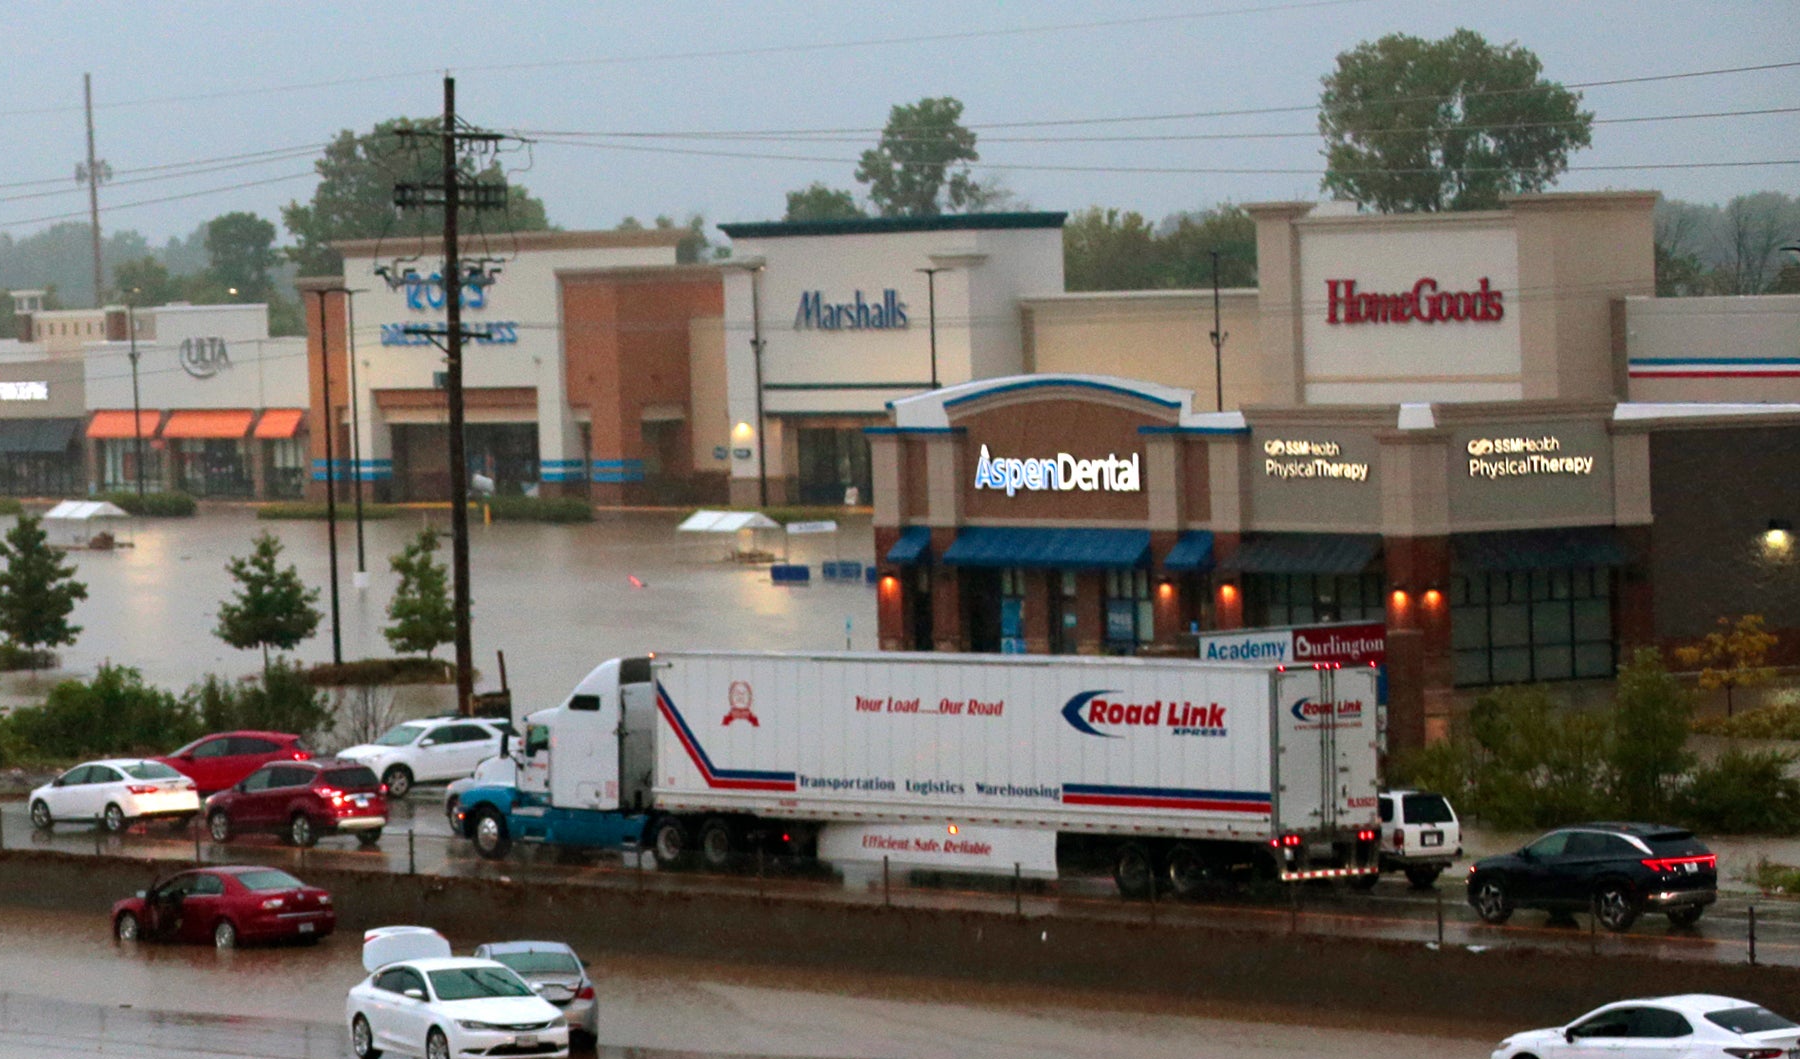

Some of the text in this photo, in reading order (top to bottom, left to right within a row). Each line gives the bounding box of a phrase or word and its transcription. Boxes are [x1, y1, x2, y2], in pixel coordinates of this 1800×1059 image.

[406, 272, 485, 309] ROS
[1325, 276, 1505, 325] HomeGoods
[793, 288, 908, 330] Marshalls
[185, 336, 230, 366] ULTA
[975, 443, 1140, 497] AspenDental
[1207, 639, 1287, 661] Academy
[1296, 635, 1384, 660] Burlington
[855, 695, 884, 712] Your
[967, 698, 1004, 717] Road
[1088, 700, 1227, 728] Road Link
[1337, 700, 1362, 714] Link
[800, 774, 1061, 801] Transportation Logistics Warehousing
[943, 839, 993, 855] Reliable
